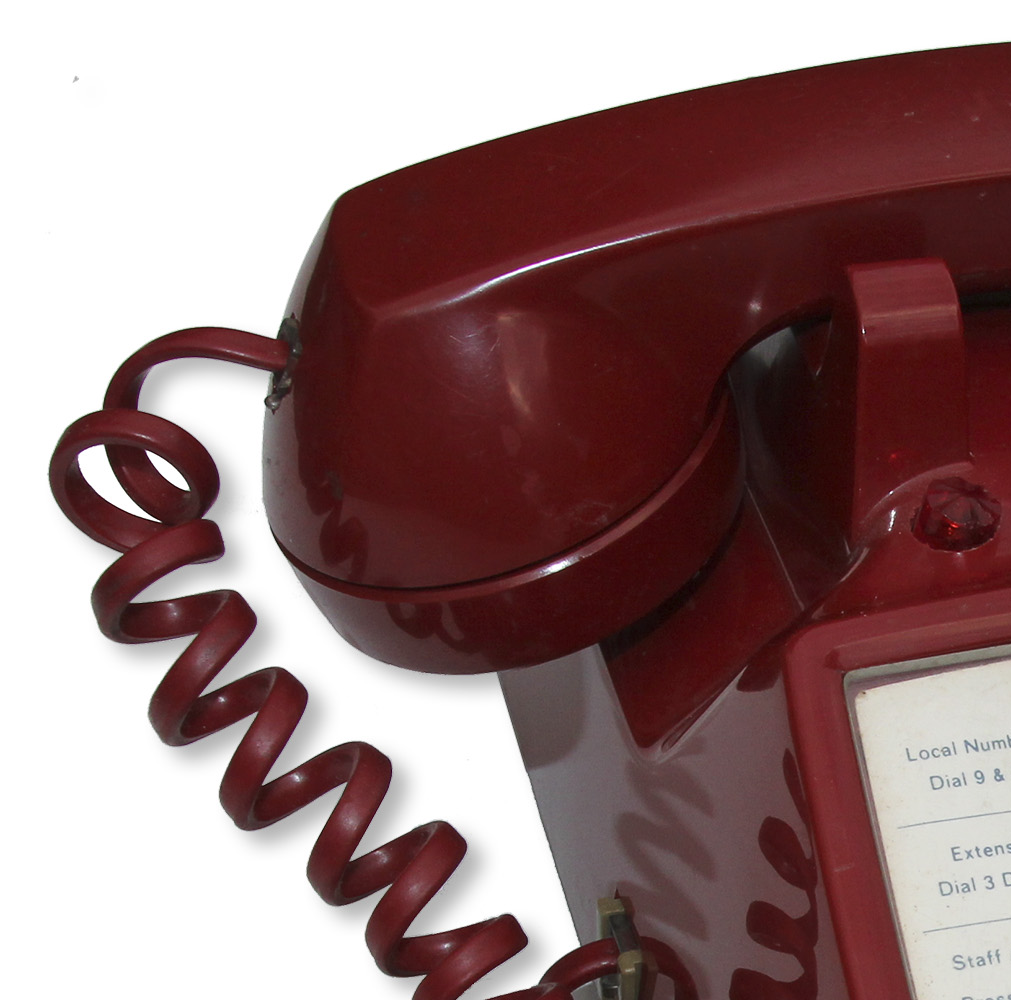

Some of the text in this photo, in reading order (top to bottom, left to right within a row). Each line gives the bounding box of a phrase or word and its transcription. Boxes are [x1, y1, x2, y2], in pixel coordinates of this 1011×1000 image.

[906, 742, 957, 762] Local
[930, 772, 967, 791] Dial
[974, 770, 985, 784] 9
[994, 769, 1005, 781] &
[938, 878, 976, 897] Dial
[985, 876, 995, 890] 3
[953, 951, 1001, 971] Staff
